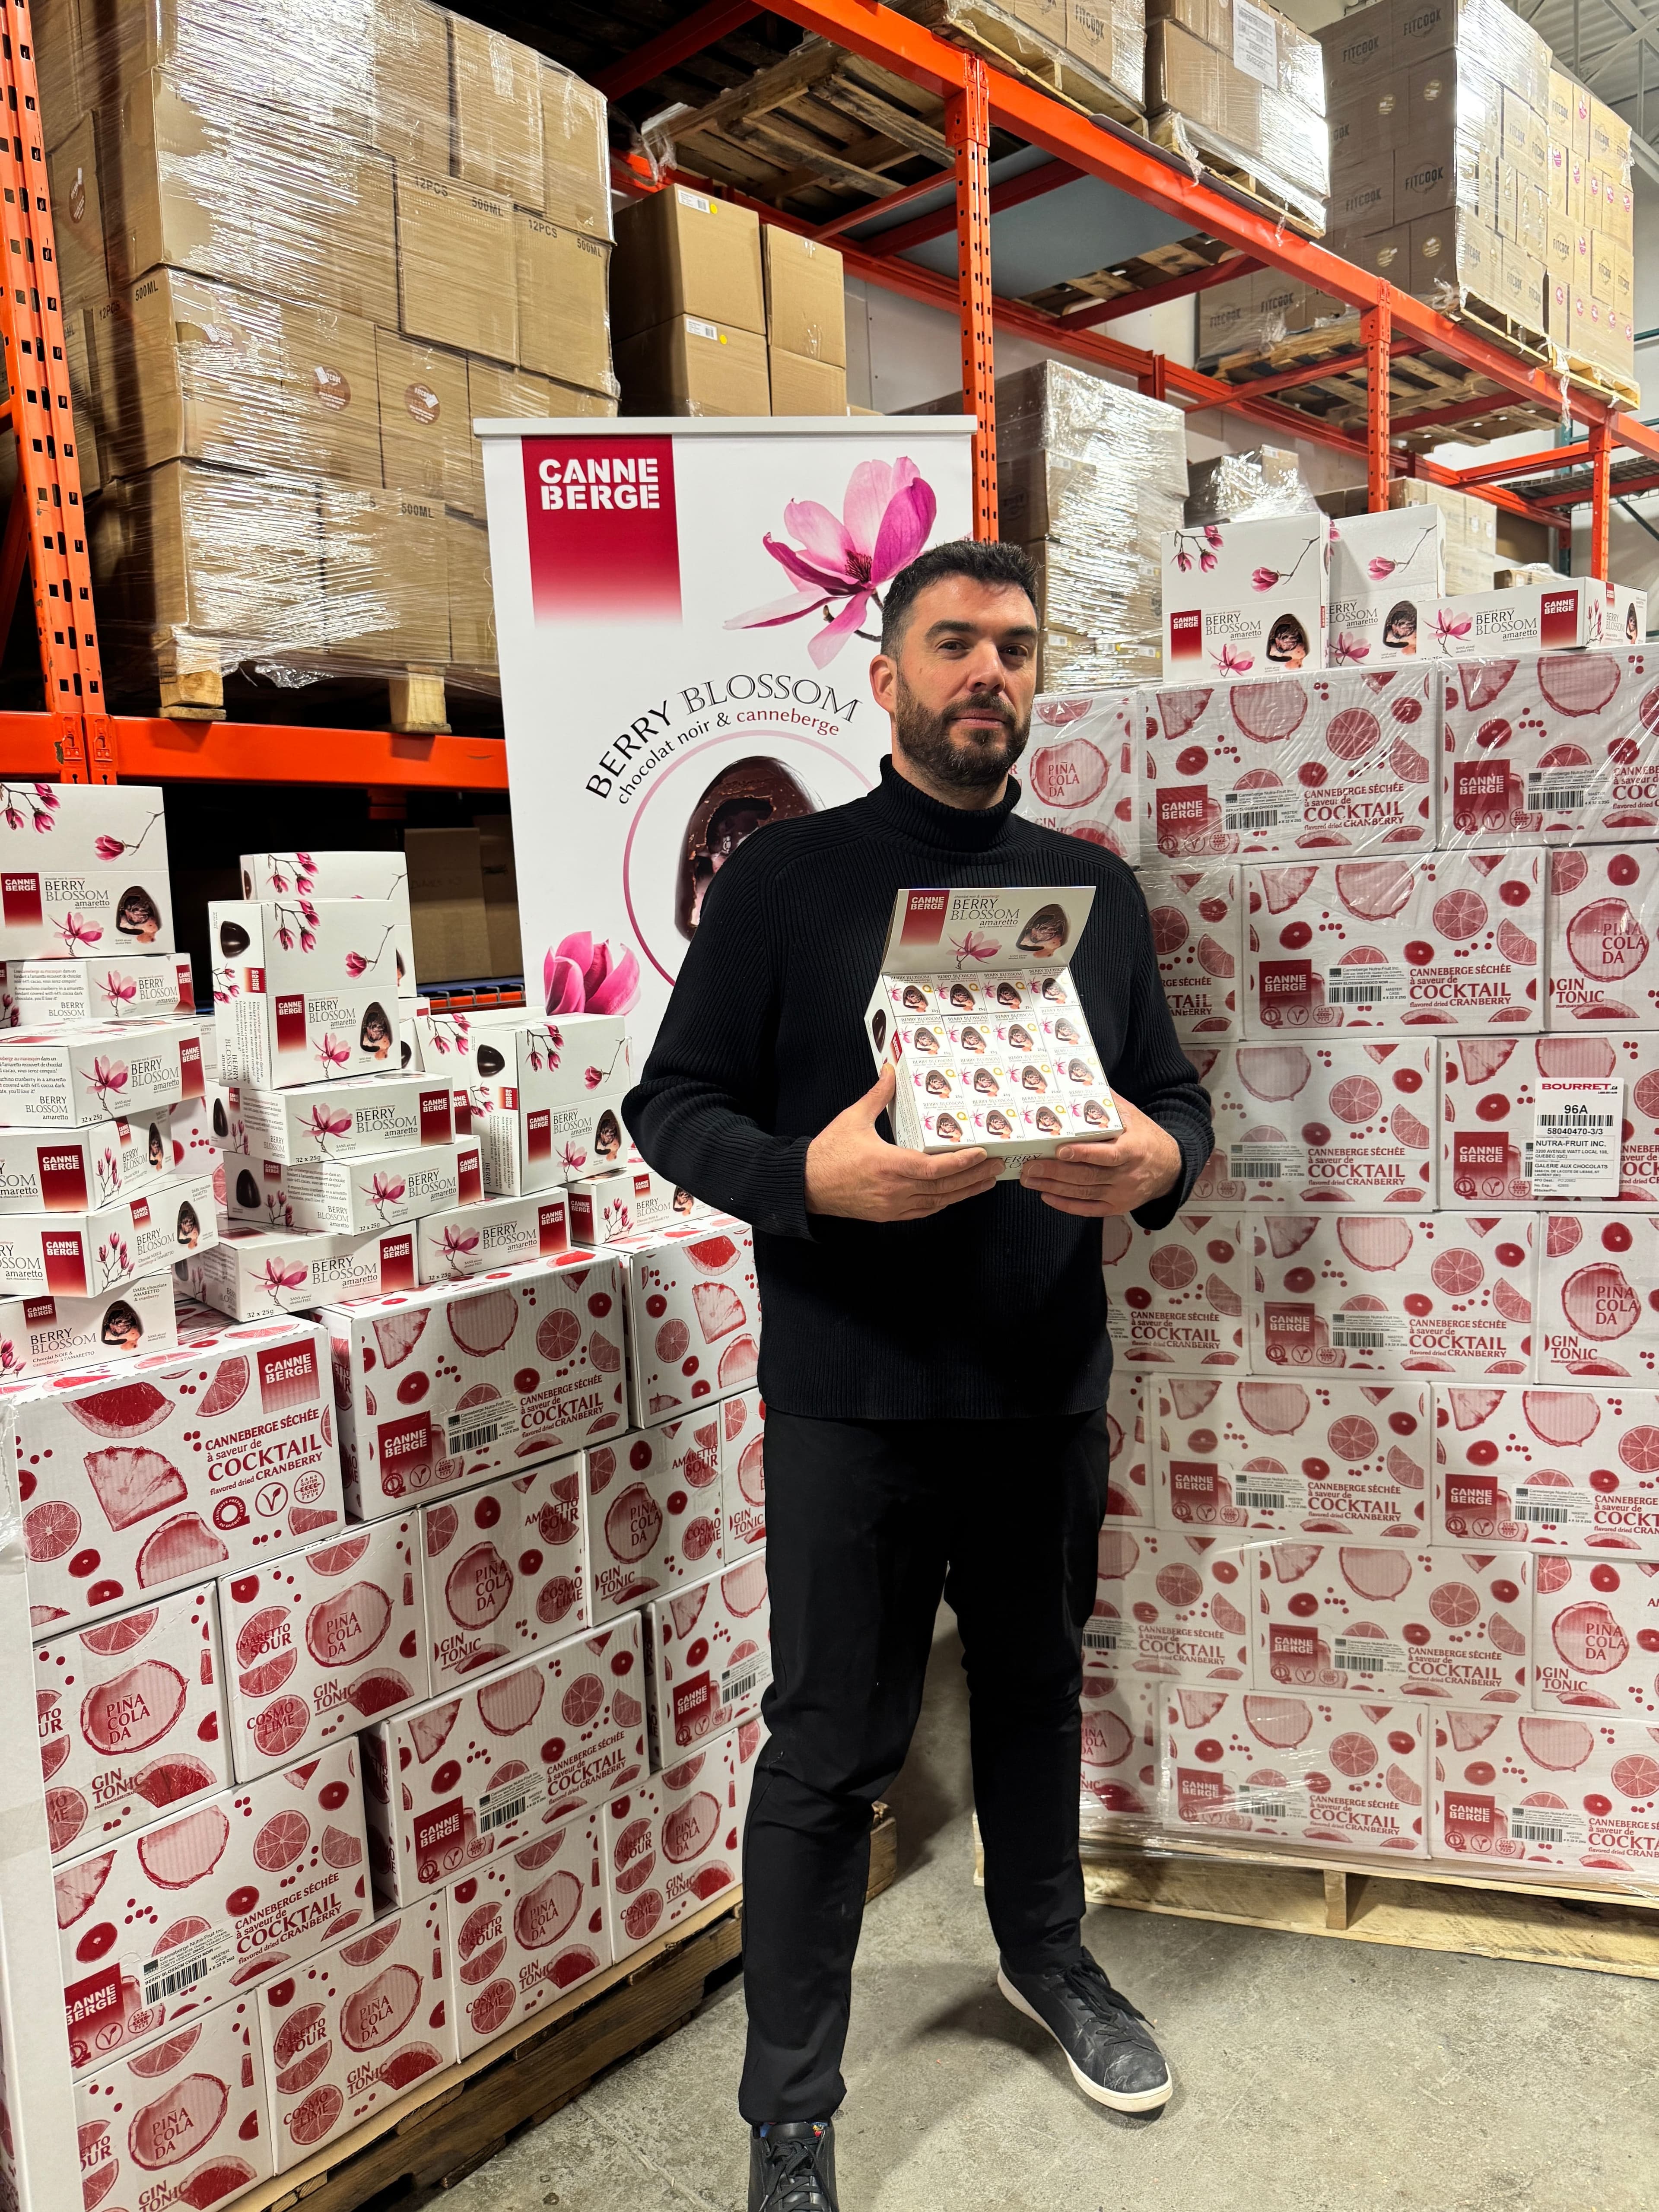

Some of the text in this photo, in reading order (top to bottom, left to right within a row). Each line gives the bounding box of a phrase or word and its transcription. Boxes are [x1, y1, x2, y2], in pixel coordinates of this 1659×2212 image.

[1404, 8, 1442, 35] FITCOOK
[1343, 36, 1379, 62] FITCOOK
[1406, 167, 1443, 190] FITCOOK
[528, 219, 601, 257] 12PCS 500ML
[136, 280, 158, 301] 500ML
[1261, 293, 1294, 312] FITCOOK
[538, 458, 658, 484] CANNE
[541, 484, 660, 511] BERGE
[401, 503, 434, 518] 500ML
[1329, 603, 1357, 614] ERRY
[1545, 598, 1574, 608] CANNE
[1545, 606, 1574, 614] BERGE
[1206, 613, 1240, 626] BERRY
[1329, 608, 1378, 623] LOSSOM
[1347, 617, 1378, 626] amaretto
[1476, 610, 1515, 624] BERRY
[1205, 621, 1262, 636] BLOSSOM
[1230, 630, 1262, 639] amaretto
[1476, 618, 1537, 636] BLOSSOM
[1503, 629, 1538, 639] amaretto
[585, 674, 862, 799] BERRY BLOSSOM
[618, 708, 839, 804] chocolat noir & canneberge
[1162, 800, 1203, 812] CANNE
[1162, 808, 1203, 820] BERGE
[45, 881, 85, 891] BERRY
[45, 890, 109, 901] BLOSSOM
[953, 899, 998, 909] BERRY
[950, 909, 1021, 920] BLOSSOM
[1602, 936, 1648, 950] COLA
[1602, 950, 1624, 964] DA
[1409, 963, 1512, 977] CANNEBERGE SÉCHÉE
[1409, 982, 1511, 1000] COCKTAIL
[1556, 978, 1585, 991] GIN
[1449, 997, 1511, 1007] CRANBERRY
[1556, 990, 1605, 1004] TONIC
[131, 1059, 162, 1075] BERRY
[131, 1067, 179, 1087] BLOSSOM
[153, 1079, 180, 1091] amaretto
[1564, 1105, 1588, 1114] 96A
[43, 1155, 79, 1164] CANNE
[43, 1162, 79, 1171] BERGE
[133, 1288, 160, 1297] AMARETTO
[138, 1294, 159, 1302] cranberry
[262, 1309, 274, 1317] 25g
[30, 1328, 72, 1345] BERRY
[31, 1333, 97, 1355] BLOSSOM
[33, 1353, 54, 1363] Chocolat
[33, 1358, 60, 1367] canneberge
[264, 1353, 311, 1374] CANNE
[265, 1363, 313, 1384] BERGE
[205, 1408, 319, 1451] CANNEBERGE SÉCHÉE
[207, 1439, 262, 1462] à saveur de
[208, 1434, 322, 1481] COCKTAIL
[210, 1452, 322, 1495] flavored dried CRANBERRY
[301, 1475, 318, 1483] SANS
[302, 1488, 318, 1496] GLUTEN
[1451, 1487, 1493, 1498] CANNE
[1451, 1495, 1493, 1506] BERGE
[326, 1611, 359, 1632] PIÑA
[327, 1622, 362, 1645] COLA
[249, 1632, 291, 1659] SOUR
[328, 1641, 346, 1658] DA
[313, 1679, 338, 1699] GIN
[313, 1684, 356, 1710] TONIC
[246, 1701, 294, 1731] COSMO
[265, 1713, 296, 1737] LIME
[159, 1945, 189, 1962] Canneberge
[211, 1949, 230, 1961] MASTER
[145, 1948, 213, 1985] BERRY BLOSSOM CHOCO NOIR
